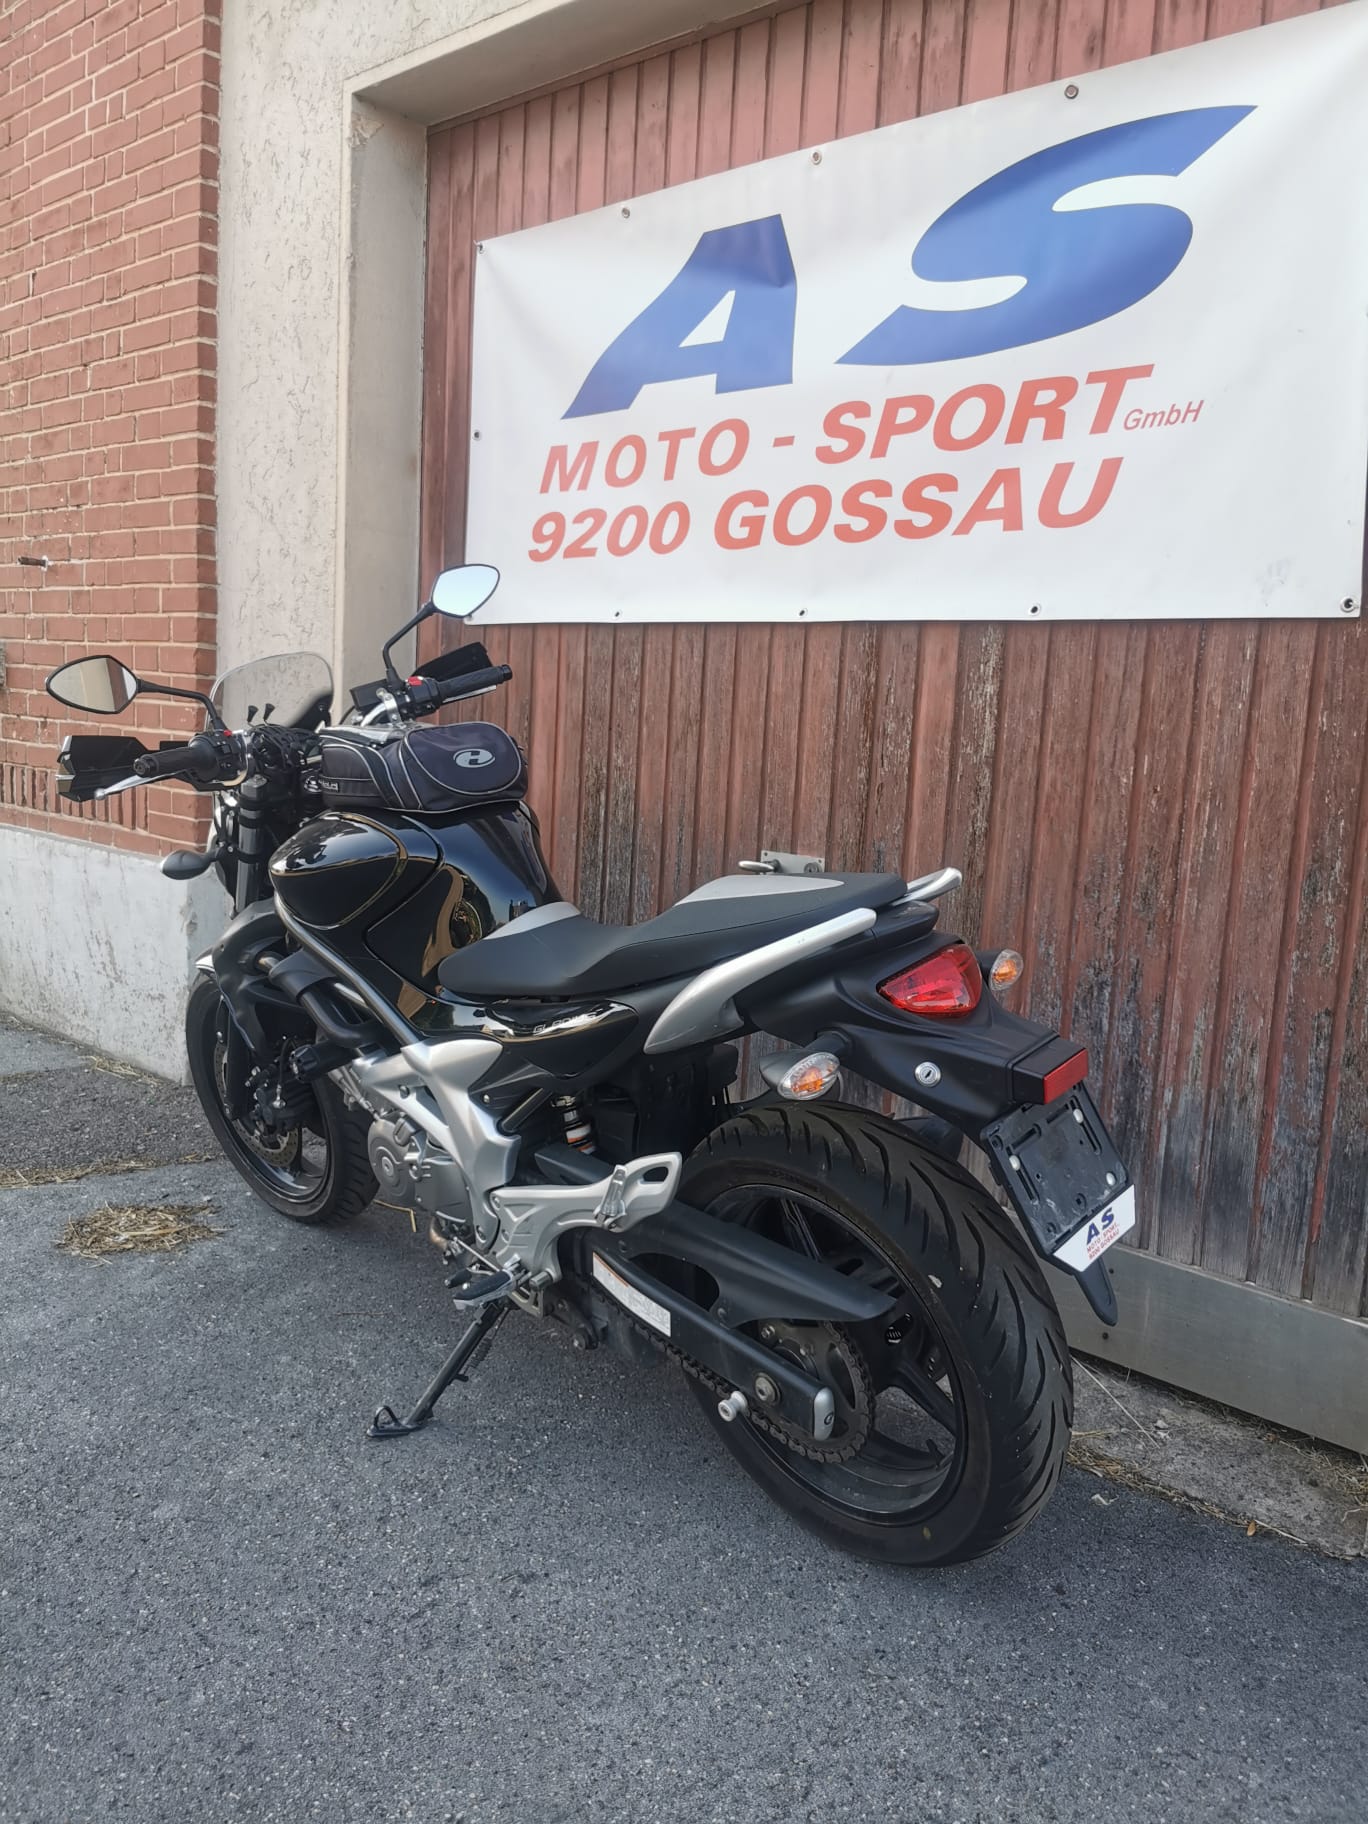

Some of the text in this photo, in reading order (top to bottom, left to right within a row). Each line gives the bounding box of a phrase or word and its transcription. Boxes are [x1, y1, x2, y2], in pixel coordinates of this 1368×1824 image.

[539, 418, 750, 494] MOTO
[815, 365, 1155, 465] SPORT
[1123, 399, 1205, 431] GmbH
[528, 457, 1124, 563] 9200 GOSSAU
[1086, 1207, 1115, 1245] AS
